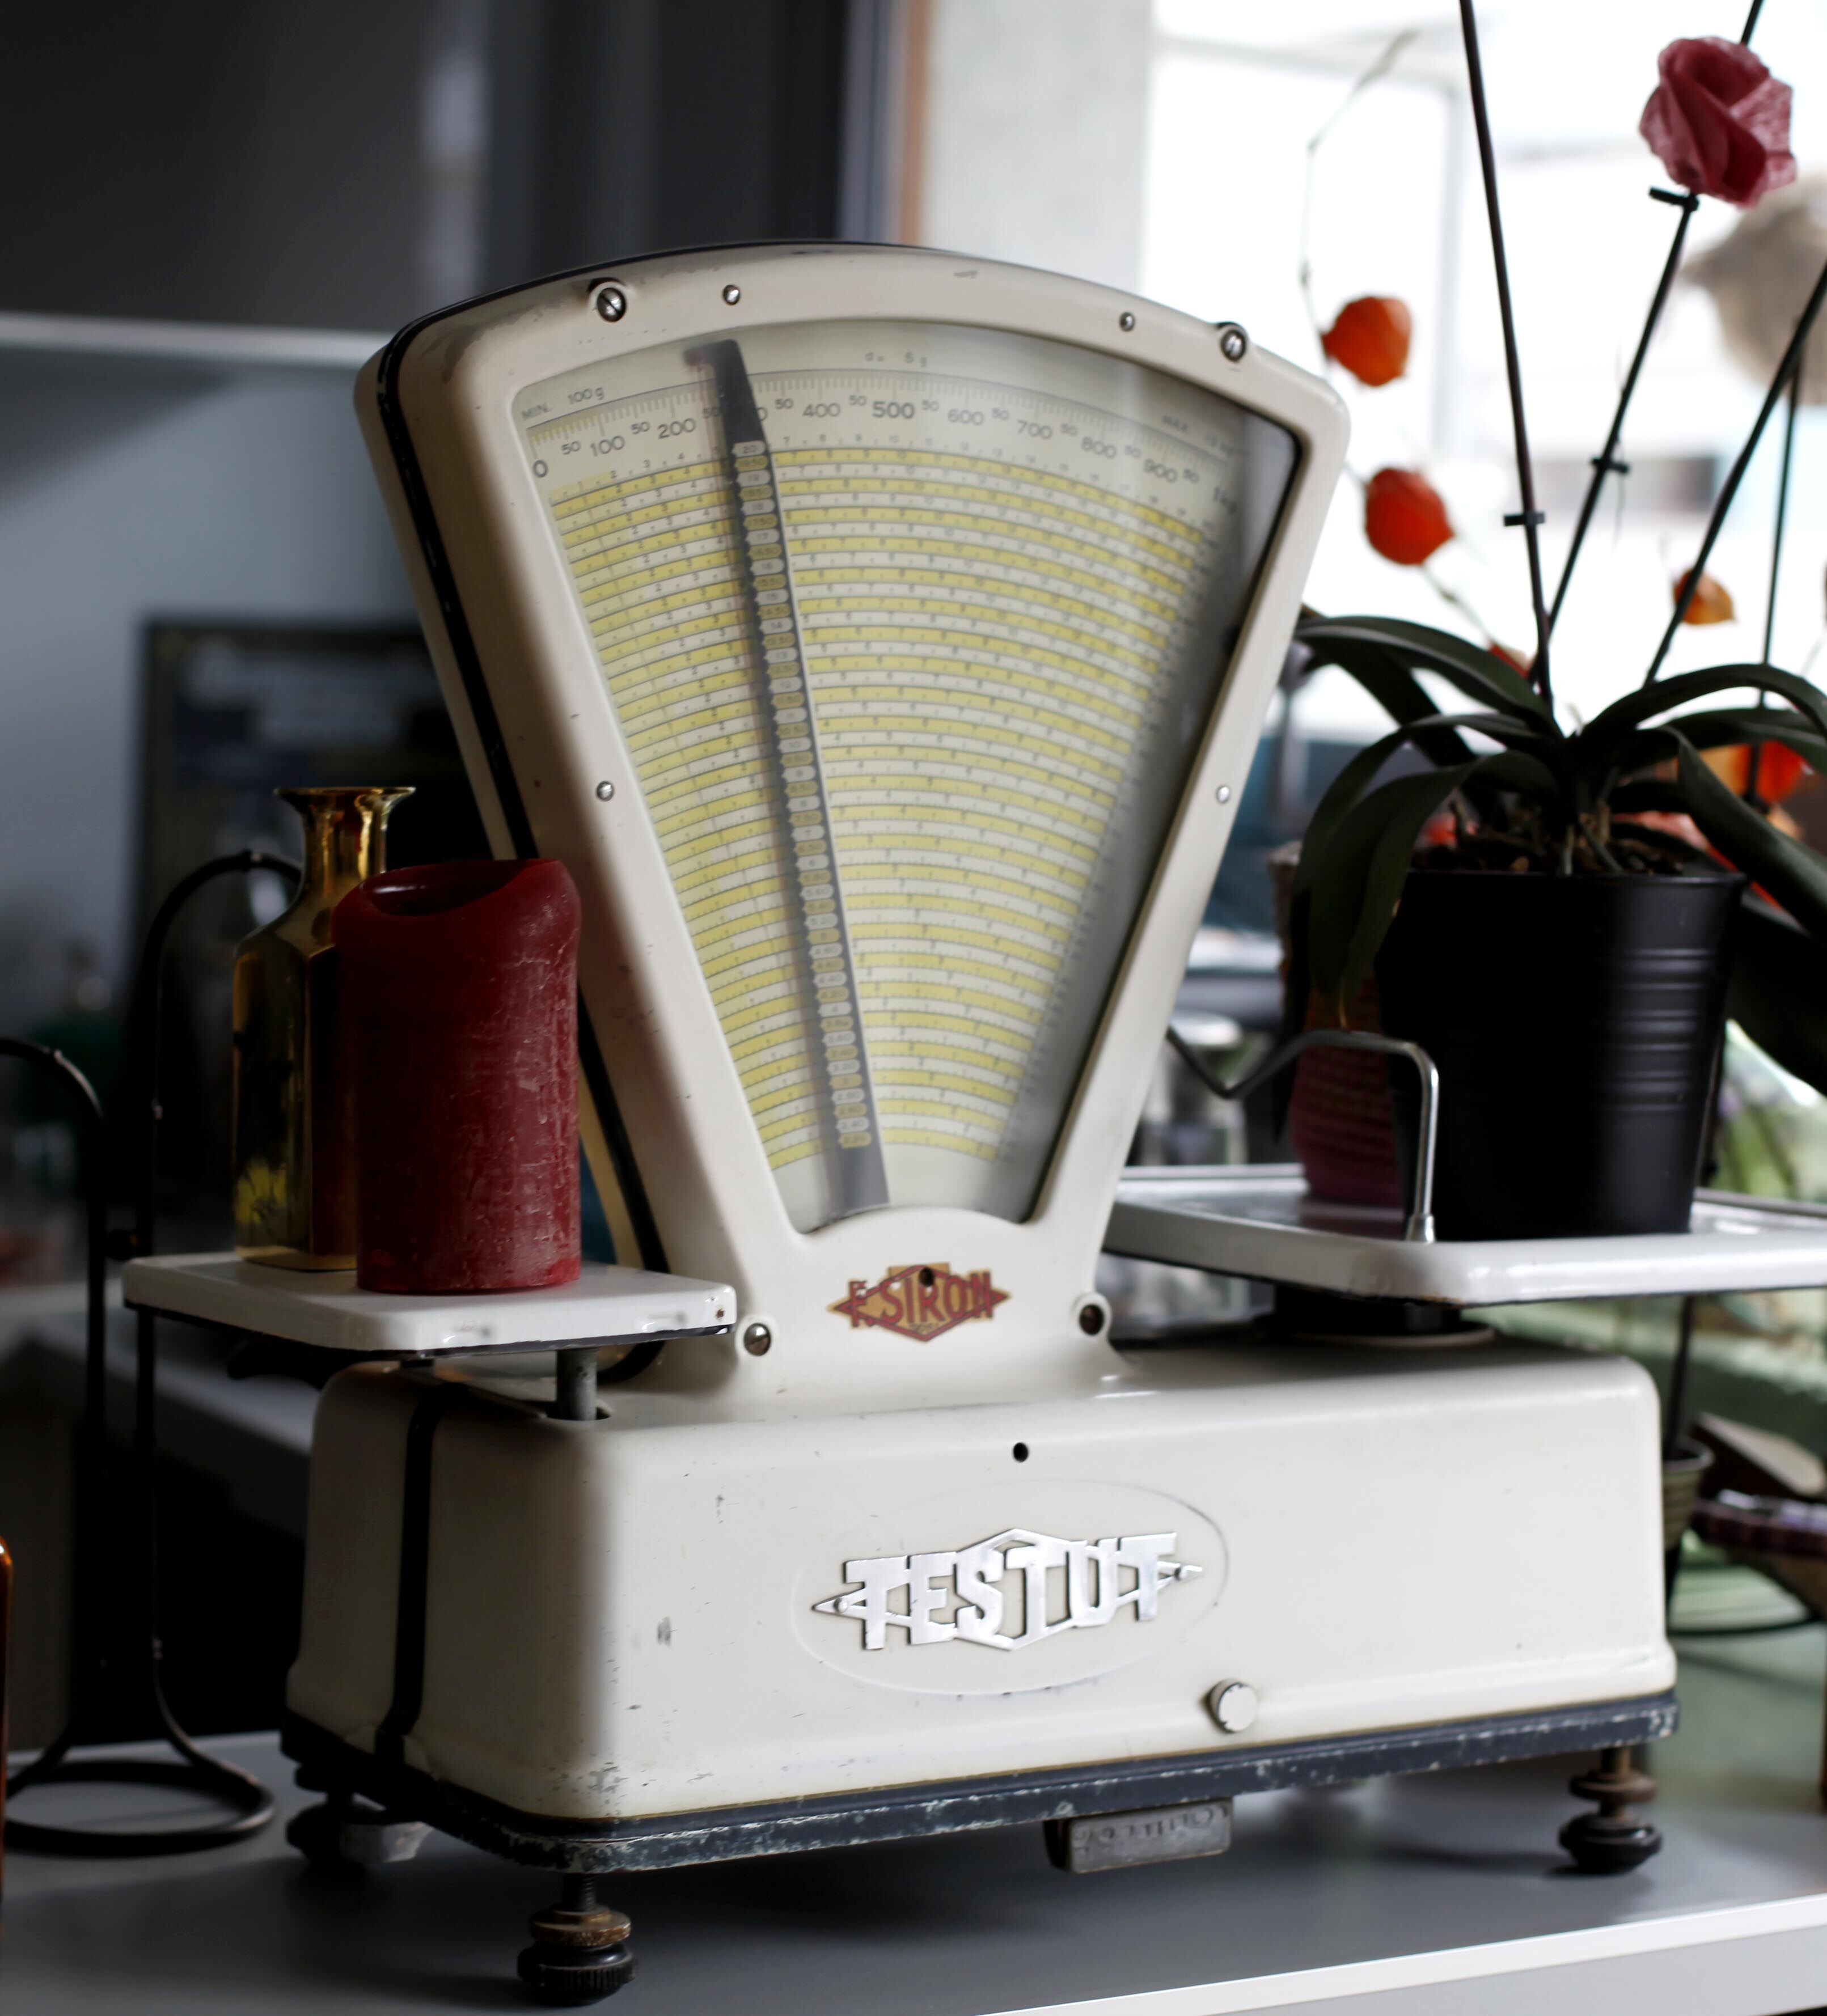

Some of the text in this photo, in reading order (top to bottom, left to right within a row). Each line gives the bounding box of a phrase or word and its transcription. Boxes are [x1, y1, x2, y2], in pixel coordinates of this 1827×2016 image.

[568, 387, 593, 404] 100
[532, 459, 549, 478] 0
[560, 440, 582, 455] 50
[589, 435, 625, 457] 100
[630, 421, 650, 435] 50
[657, 418, 697, 440] 200
[774, 397, 794, 410] 50
[801, 402, 841, 418] 400
[848, 394, 868, 406] 50
[872, 400, 915, 420] 500
[921, 399, 940, 412] 50
[948, 408, 985, 426] 600
[992, 408, 1010, 421] 50
[1017, 420, 1054, 440] 700
[1060, 423, 1079, 436] 50
[1081, 436, 1118, 459] 800
[1124, 445, 1142, 458] 50
[1143, 458, 1178, 483] 900
[1183, 468, 1200, 483] 50
[880, 1271, 993, 1325] SIRON
[844, 1532, 1178, 1650] TESTUT
